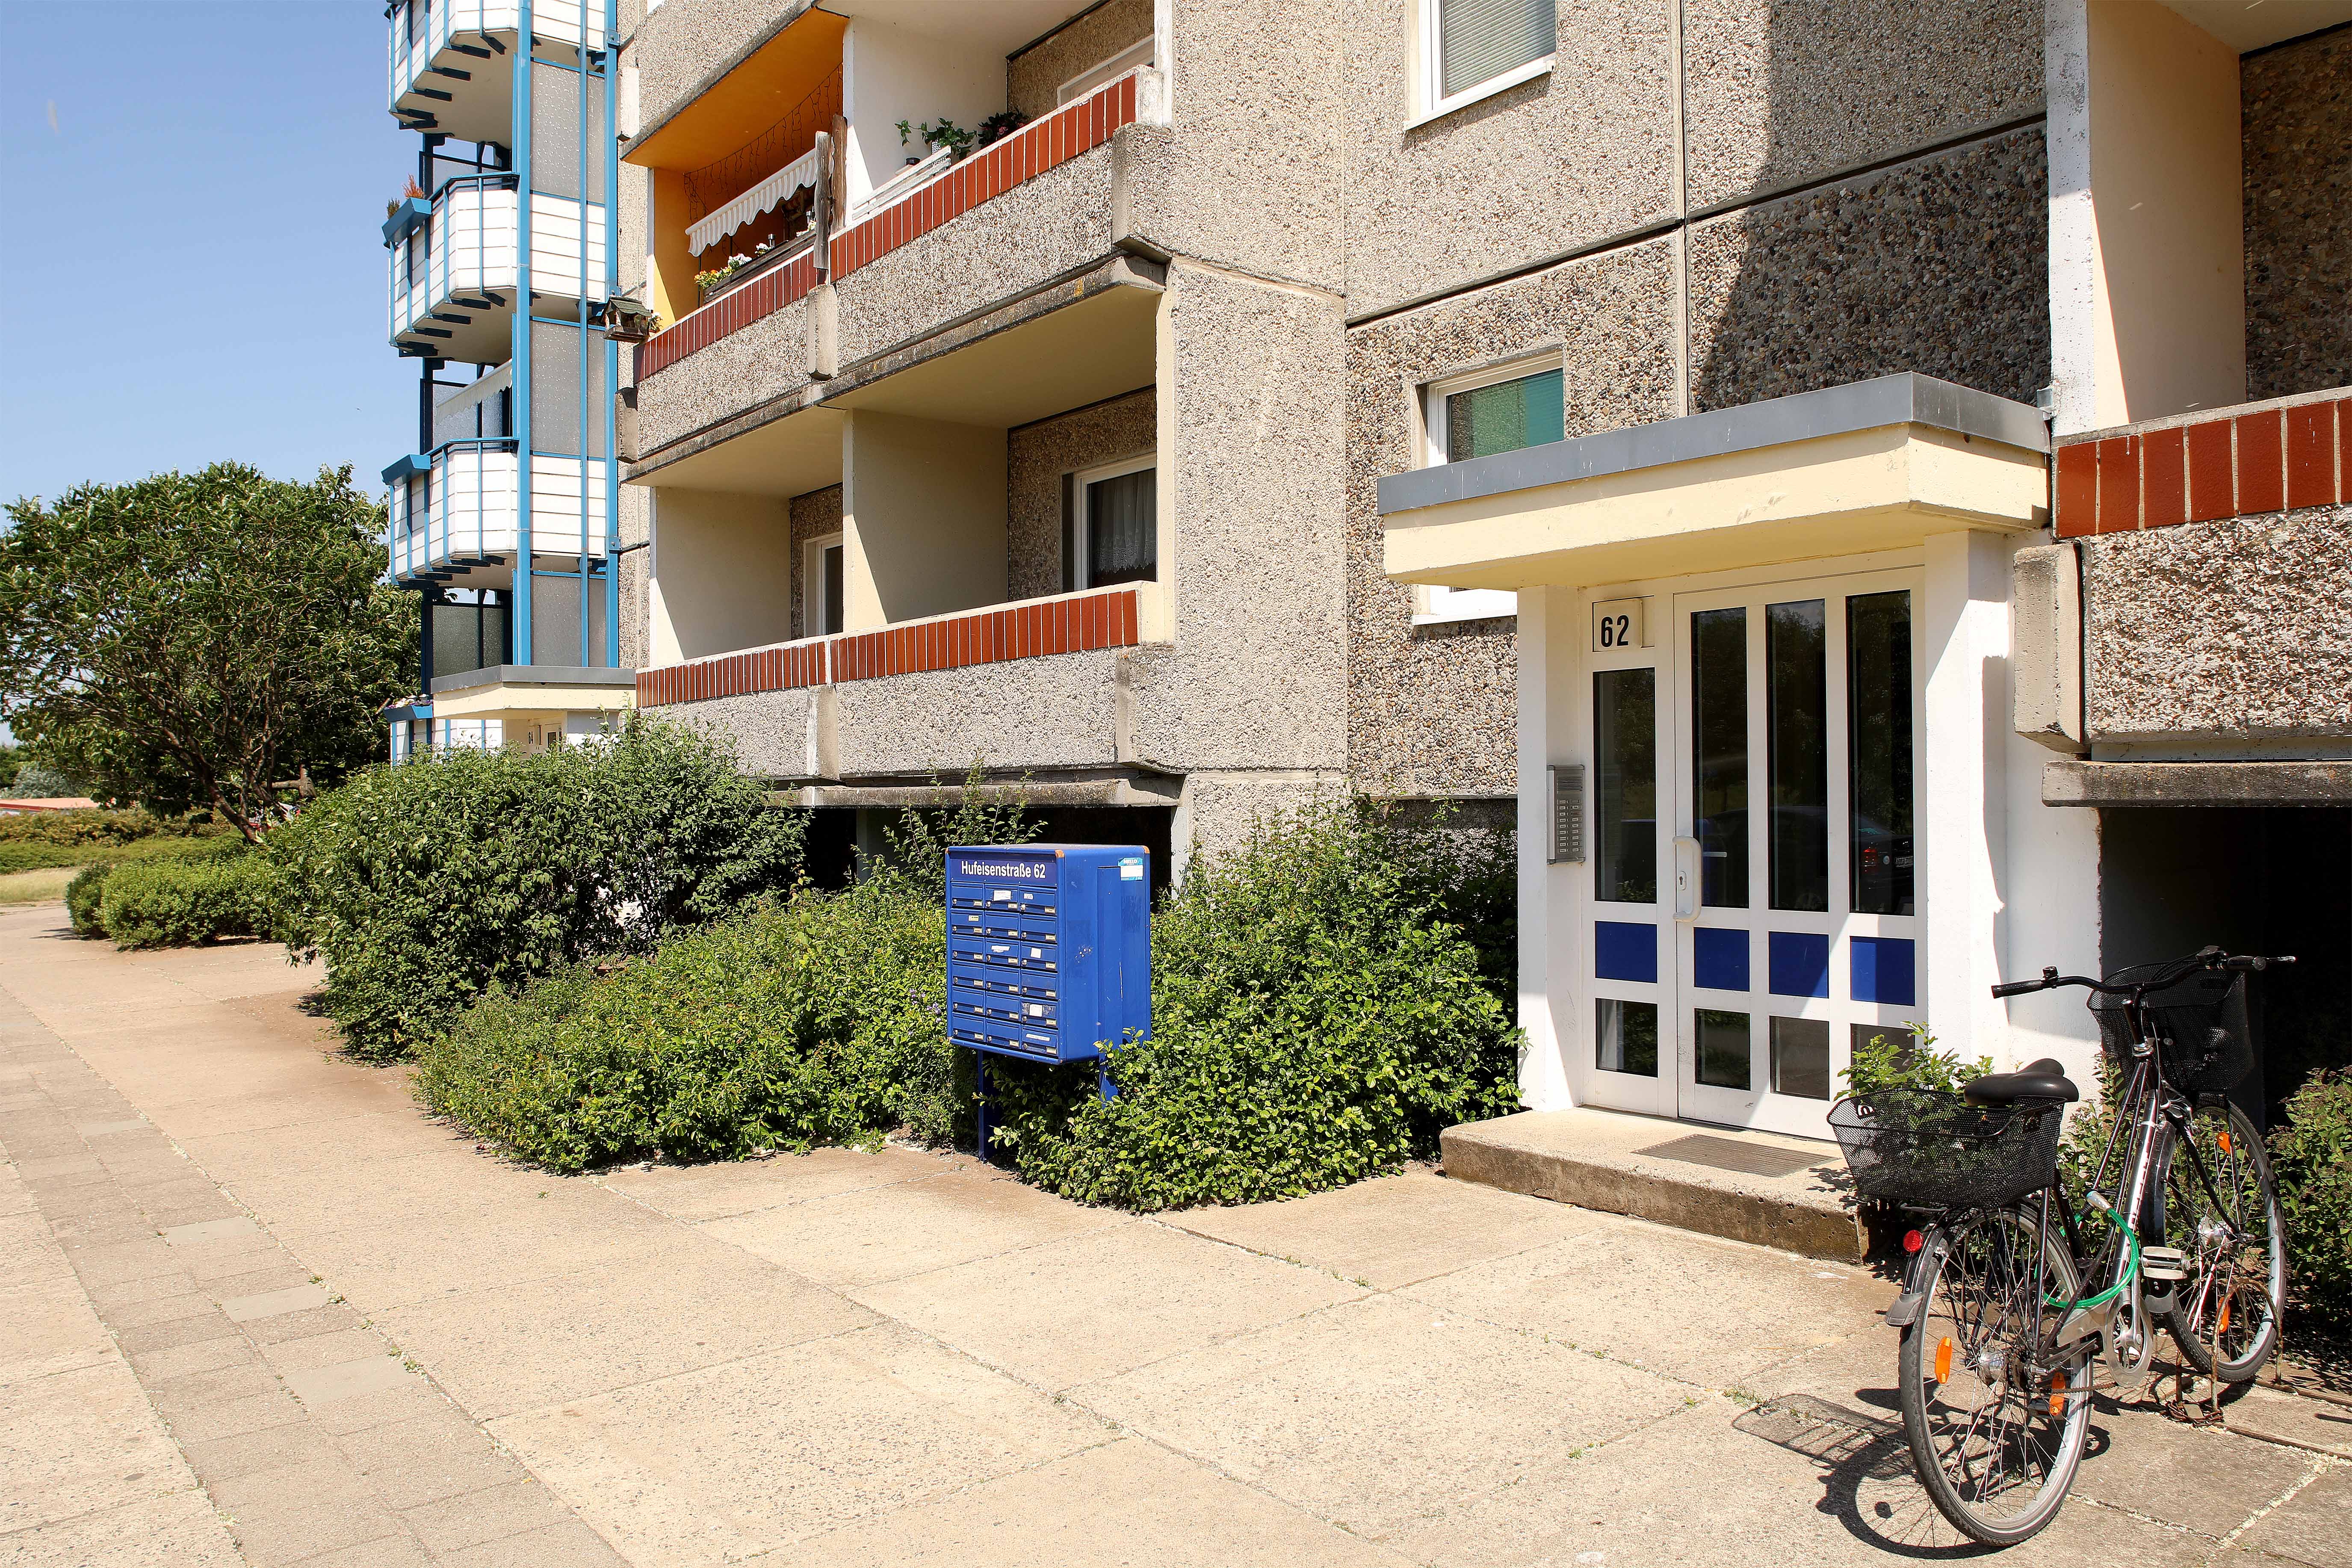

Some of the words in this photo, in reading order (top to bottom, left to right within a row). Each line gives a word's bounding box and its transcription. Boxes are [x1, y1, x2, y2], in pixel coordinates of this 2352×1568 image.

[1601, 615, 1629, 647] 62
[529, 731, 533, 744] 64
[961, 860, 1031, 878] Hufeisenstraße
[1034, 863, 1046, 879] 62
